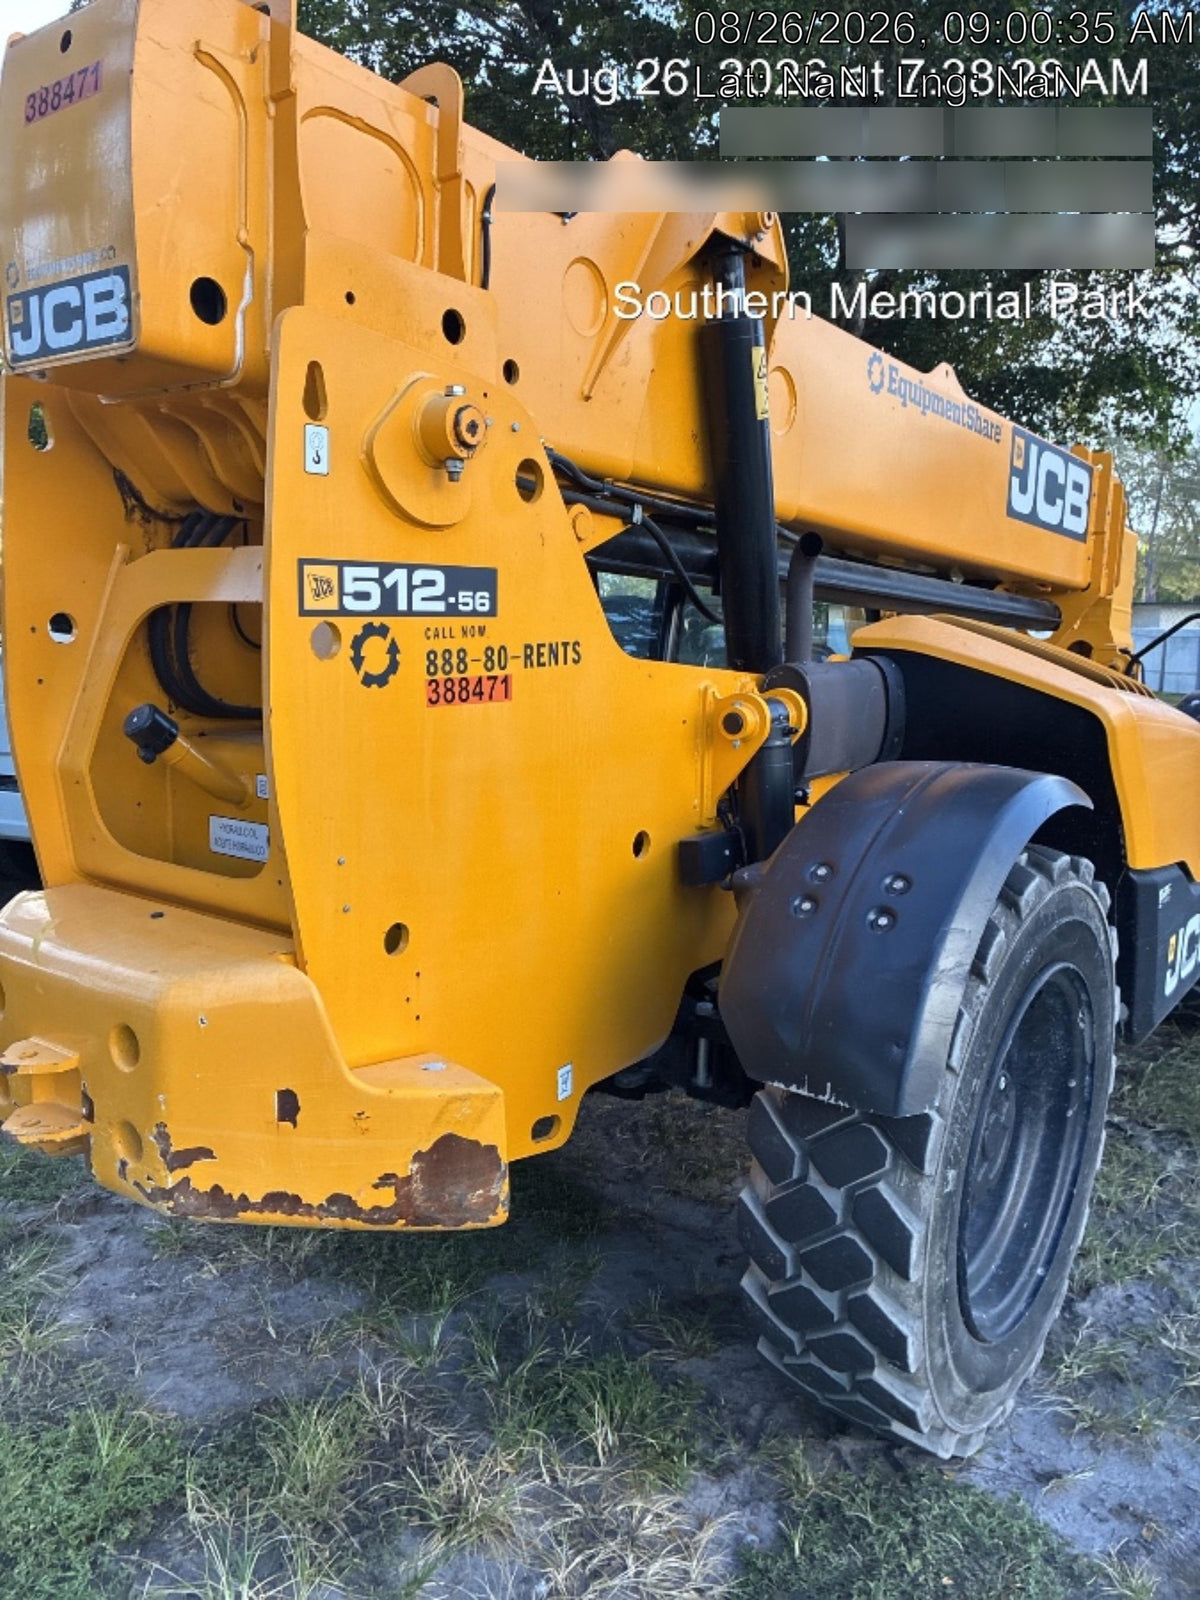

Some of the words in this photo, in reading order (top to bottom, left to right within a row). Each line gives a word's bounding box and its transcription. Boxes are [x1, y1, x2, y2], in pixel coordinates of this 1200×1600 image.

[25, 62, 101, 124] 388471
[11, 274, 129, 357] JCB
[887, 363, 1002, 444] EquipmentShare
[1010, 443, 1091, 534] JCB
[424, 626, 456, 640] CALL
[461, 625, 487, 639] NOW
[426, 641, 582, 677] 888-80-RENTS
[427, 674, 510, 705] 388471
[1164, 912, 1200, 997] JC
